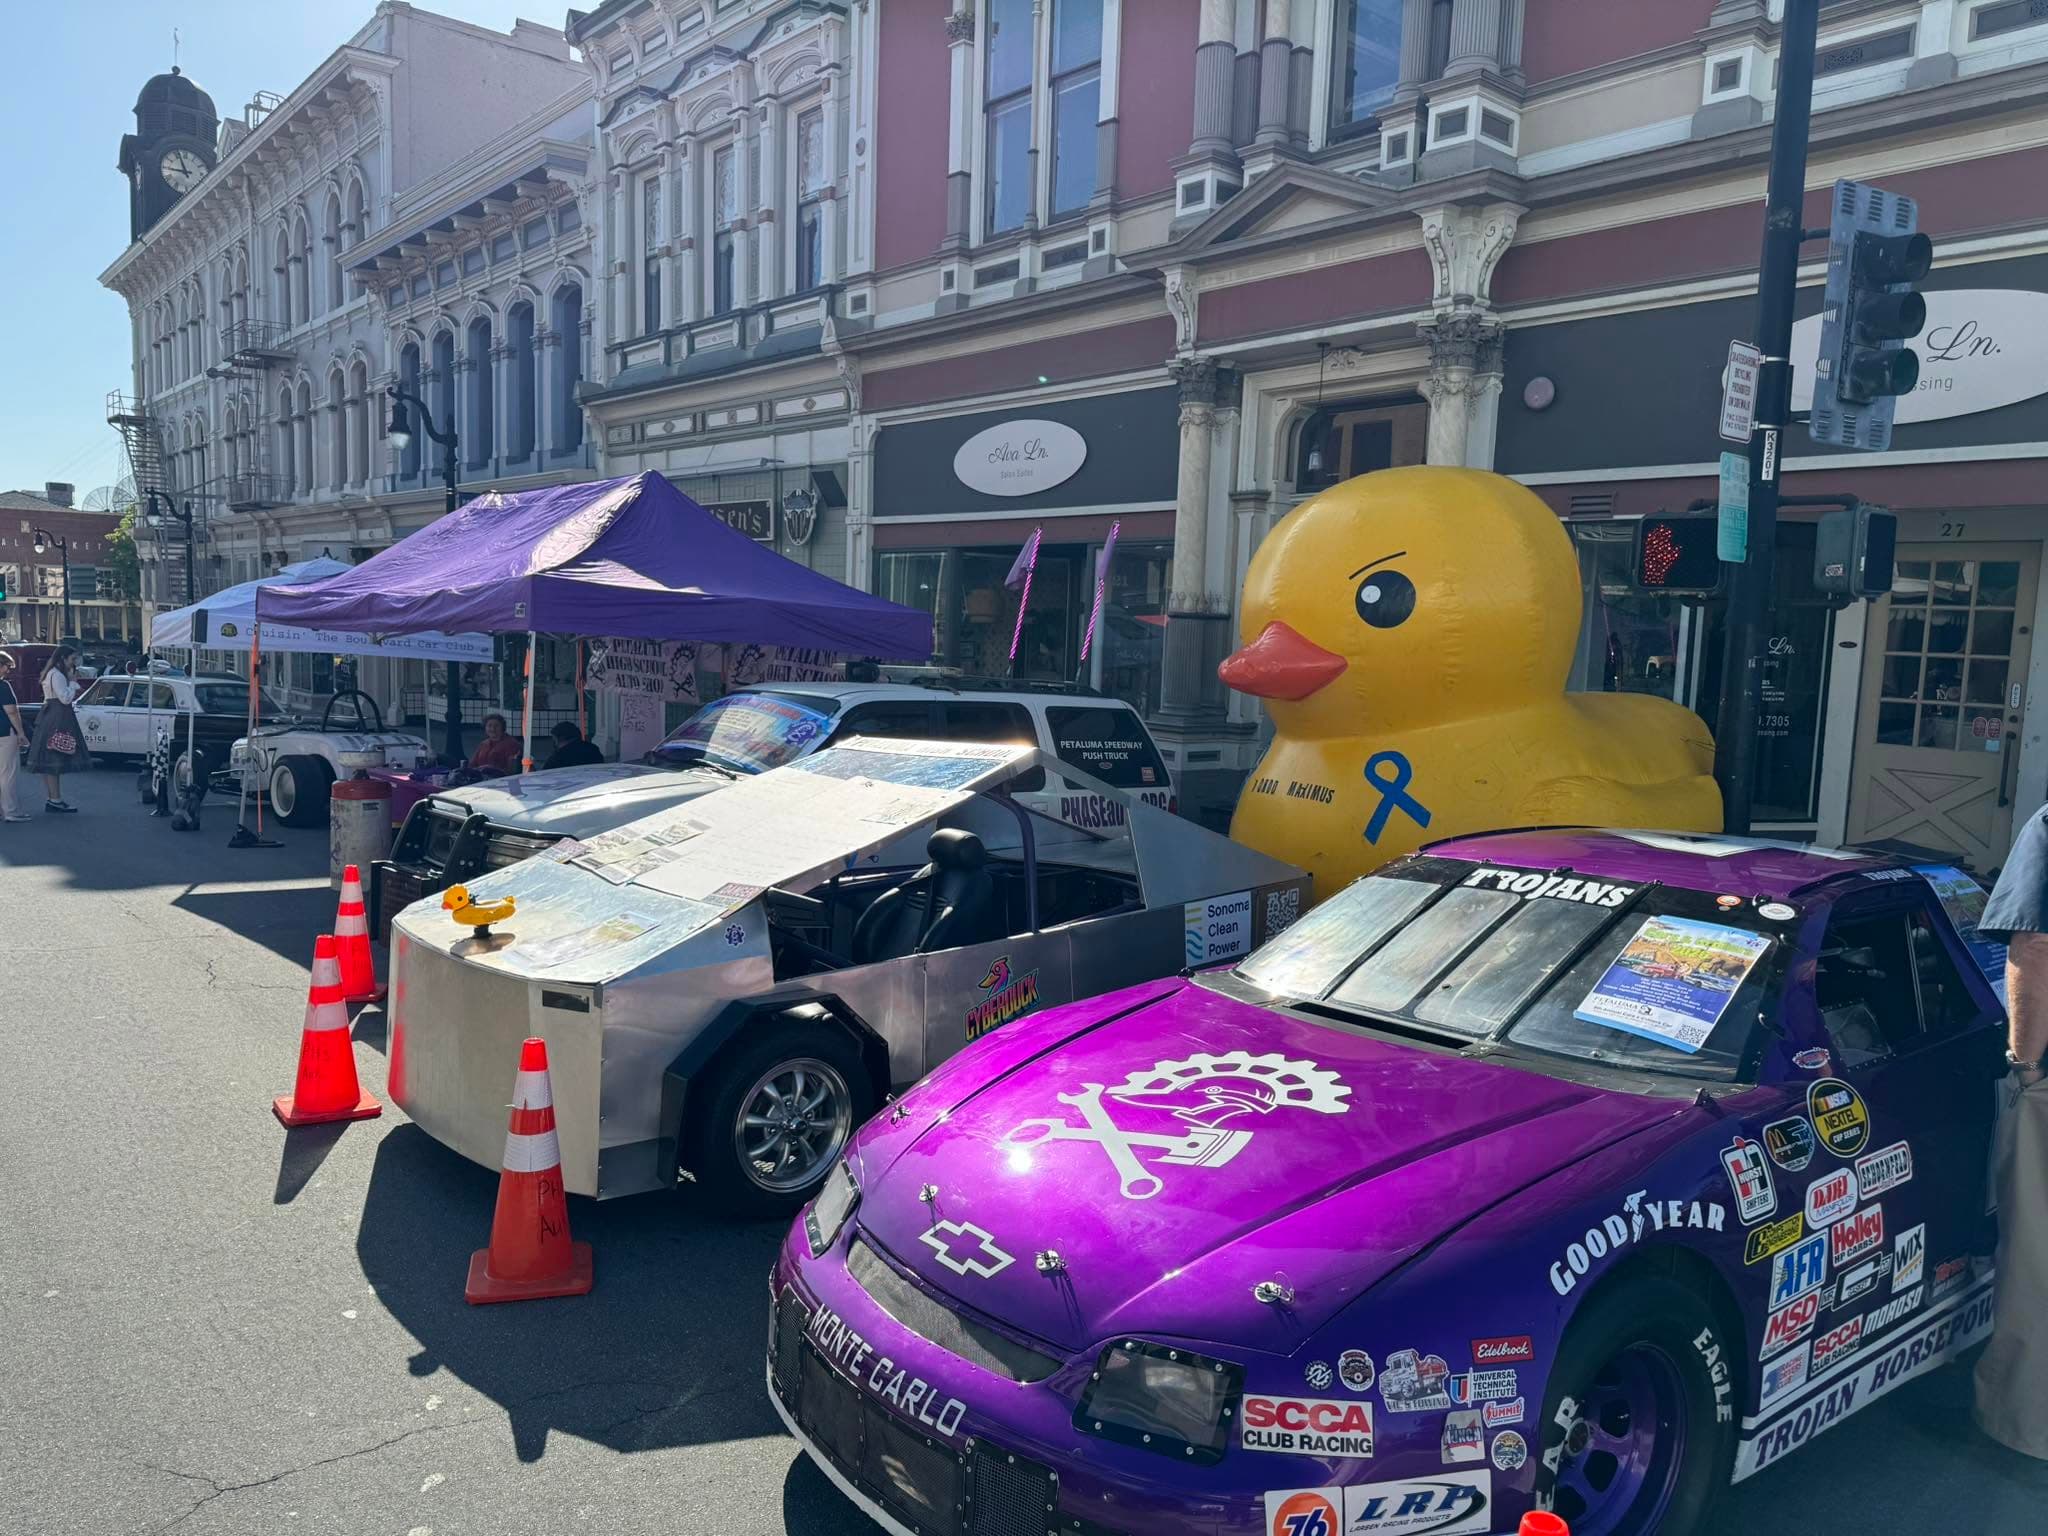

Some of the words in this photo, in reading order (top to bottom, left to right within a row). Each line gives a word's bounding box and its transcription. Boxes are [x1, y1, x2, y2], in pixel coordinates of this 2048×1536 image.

[1926, 320, 2001, 363] Ln.
[1911, 376, 1953, 392] sing
[987, 441, 1020, 464] Ava
[1023, 438, 1049, 461] Ln.
[1765, 432, 1776, 479] K3201
[1941, 523, 1966, 537] 27
[245, 628, 307, 641] Cuisin'
[315, 631, 339, 643] The
[345, 634, 412, 649] Bouvard
[416, 639, 438, 650] Car
[445, 640, 475, 652] Club
[1767, 636, 1796, 655] Ln.
[1060, 740, 1103, 749] PETALUMA
[1103, 740, 1144, 750] SPEEDWAY
[1082, 751, 1103, 760] PUSH
[1104, 751, 1129, 760] TRUCK
[1286, 780, 1336, 804] MAXIMUS
[1463, 867, 1636, 908] TROJANS
[1207, 900, 1250, 918] Sonoma
[1208, 921, 1239, 938] Clean
[1208, 939, 1241, 957] Power
[965, 975, 1038, 1041] CYBERDUCK
[1823, 1110, 1860, 1132] NEXTEL
[1832, 1132, 1845, 1144] CUP
[1844, 1126, 1861, 1140] SERIES
[1737, 1166, 1763, 1184] HURST
[1833, 1211, 1880, 1255] Holley
[1834, 1252, 1845, 1266] HP
[1846, 1238, 1875, 1257] CARBS
[1896, 1228, 1923, 1273] WIX
[1776, 1237, 1825, 1304] AFR
[1765, 1293, 1818, 1346] MSD
[808, 1302, 874, 1377] MONTE
[1476, 1341, 1530, 1359] Edelbrock
[1813, 1318, 1861, 1360] SCCA
[1811, 1355, 1831, 1374] CLUB
[1830, 1337, 1860, 1363] RACING
[1472, 1369, 1517, 1382] UNIVERSAL
[1472, 1379, 1517, 1391] TECHNICAL
[1692, 1326, 1733, 1424] EAGLE
[867, 1356, 968, 1438] CARLO
[1472, 1388, 1517, 1400] INSTITUTE
[1244, 1398, 1371, 1433] SCCA
[1486, 1402, 1521, 1420] SUMMIT
[1754, 1376, 1860, 1469] TROJAN
[1243, 1429, 1294, 1449] CLUB
[1299, 1434, 1373, 1454] RACING
[1354, 1485, 1478, 1523] LRP
[1283, 1506, 1328, 1536] 76
[1349, 1522, 1380, 1533] LARSEN
[1381, 1518, 1411, 1529] RACING
[1412, 1512, 1453, 1524] PRODUCTS
